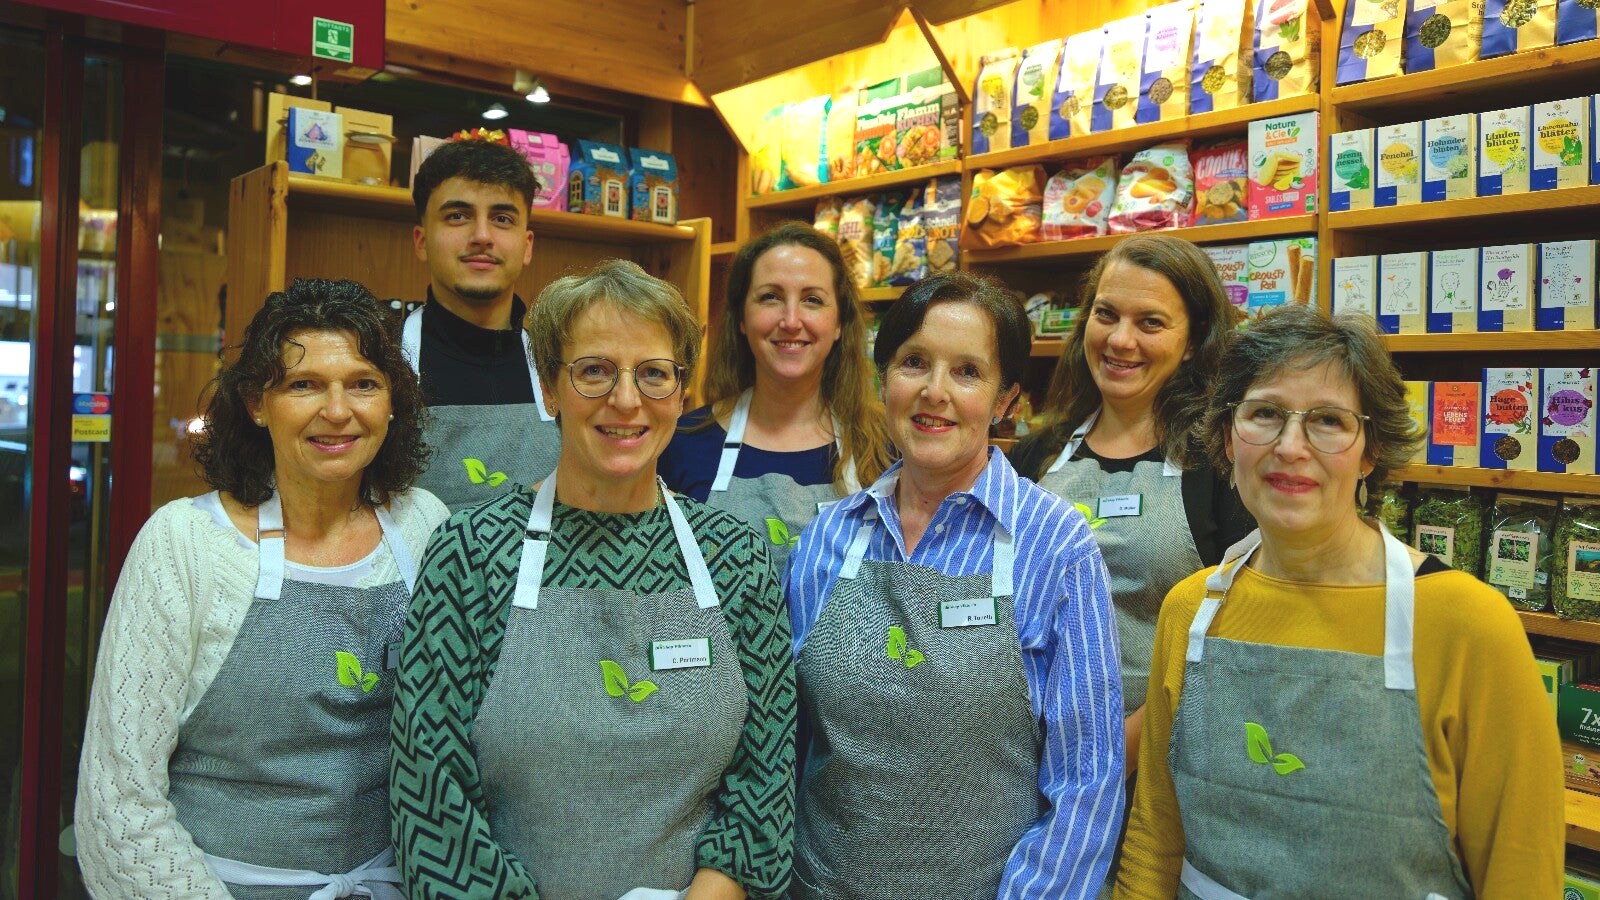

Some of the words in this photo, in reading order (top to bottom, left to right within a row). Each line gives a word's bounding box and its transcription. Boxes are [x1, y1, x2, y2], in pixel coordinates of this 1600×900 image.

[896, 104, 941, 120] Flamm
[896, 112, 940, 131] KUCHEN
[1265, 120, 1297, 131] Nature
[1485, 131, 1520, 141] Linden
[1427, 137, 1466, 148] Holunder
[1336, 151, 1363, 160] Brenn
[1380, 150, 1414, 160] Fenchel
[1336, 157, 1363, 167] nessel
[1490, 395, 1516, 405] Hage
[1553, 396, 1580, 404] Hibis
